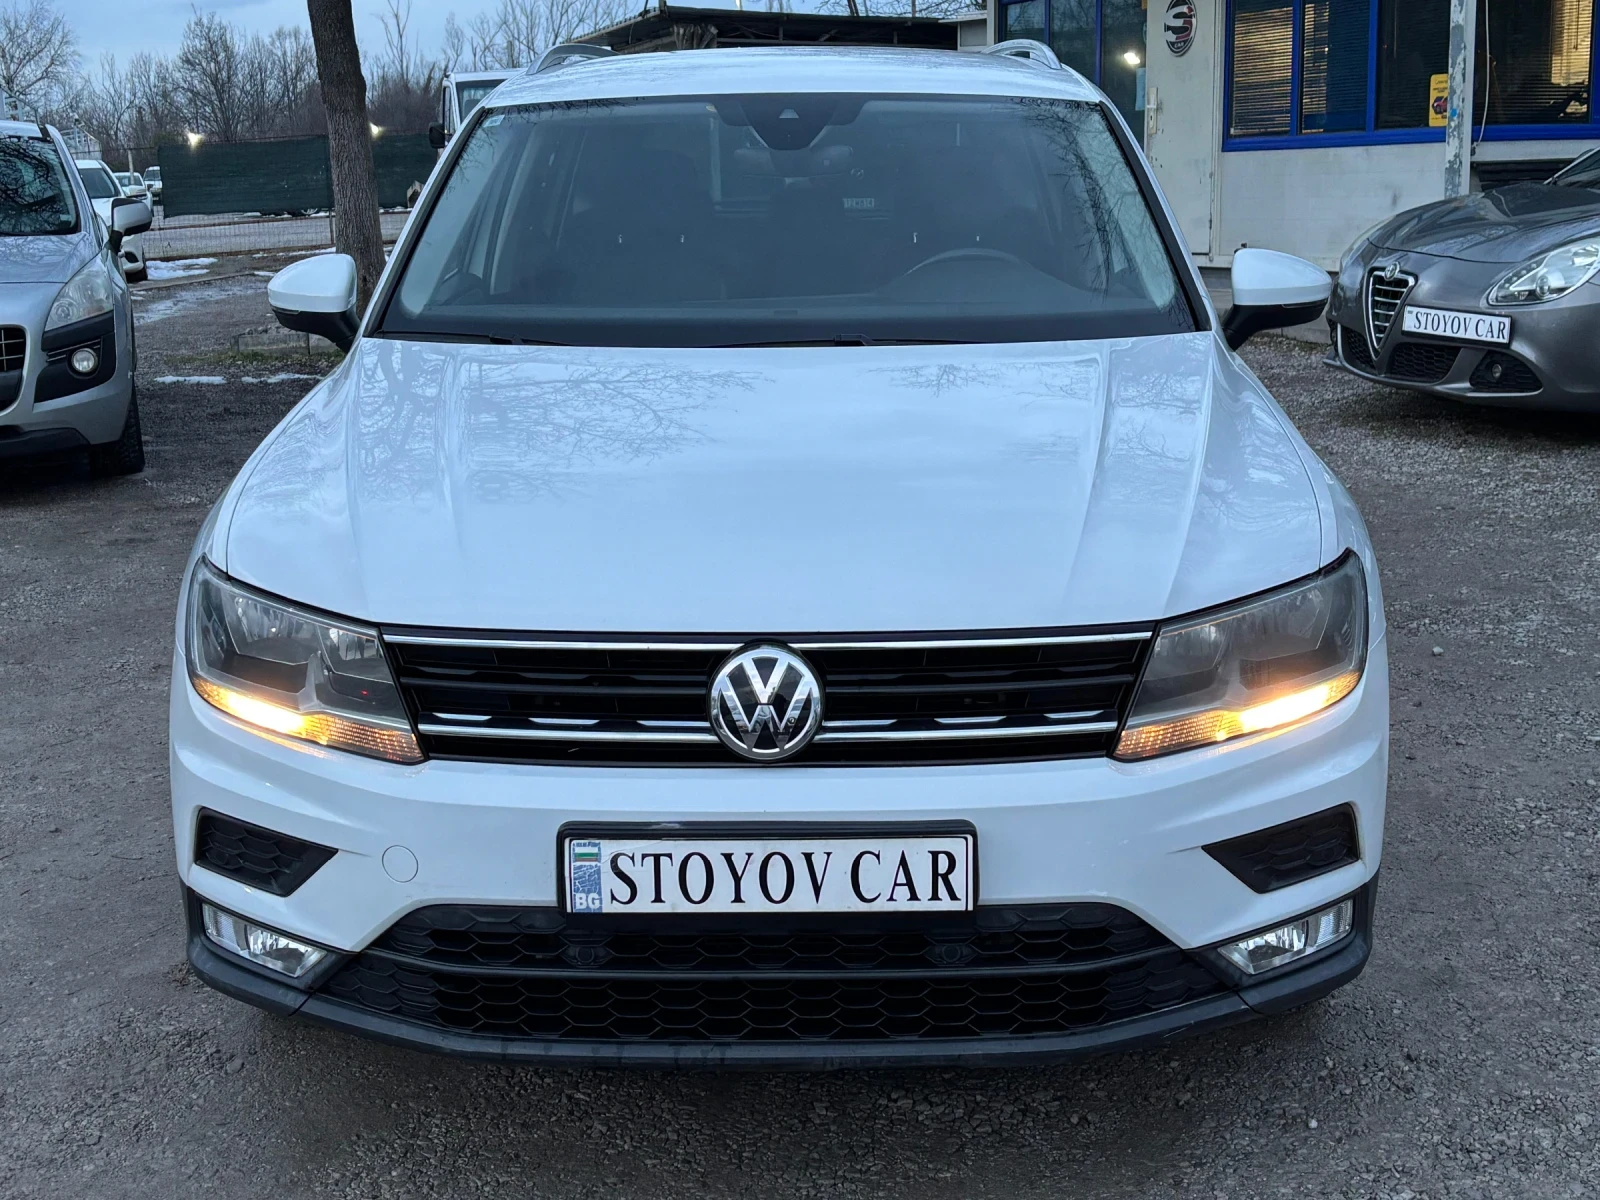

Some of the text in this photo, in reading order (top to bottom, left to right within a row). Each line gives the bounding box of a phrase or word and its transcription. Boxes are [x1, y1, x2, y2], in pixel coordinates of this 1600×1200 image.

[1414, 311, 1506, 340] STOYOV CAR
[610, 850, 962, 905] STOYOV CAR
[575, 893, 600, 909] BG
